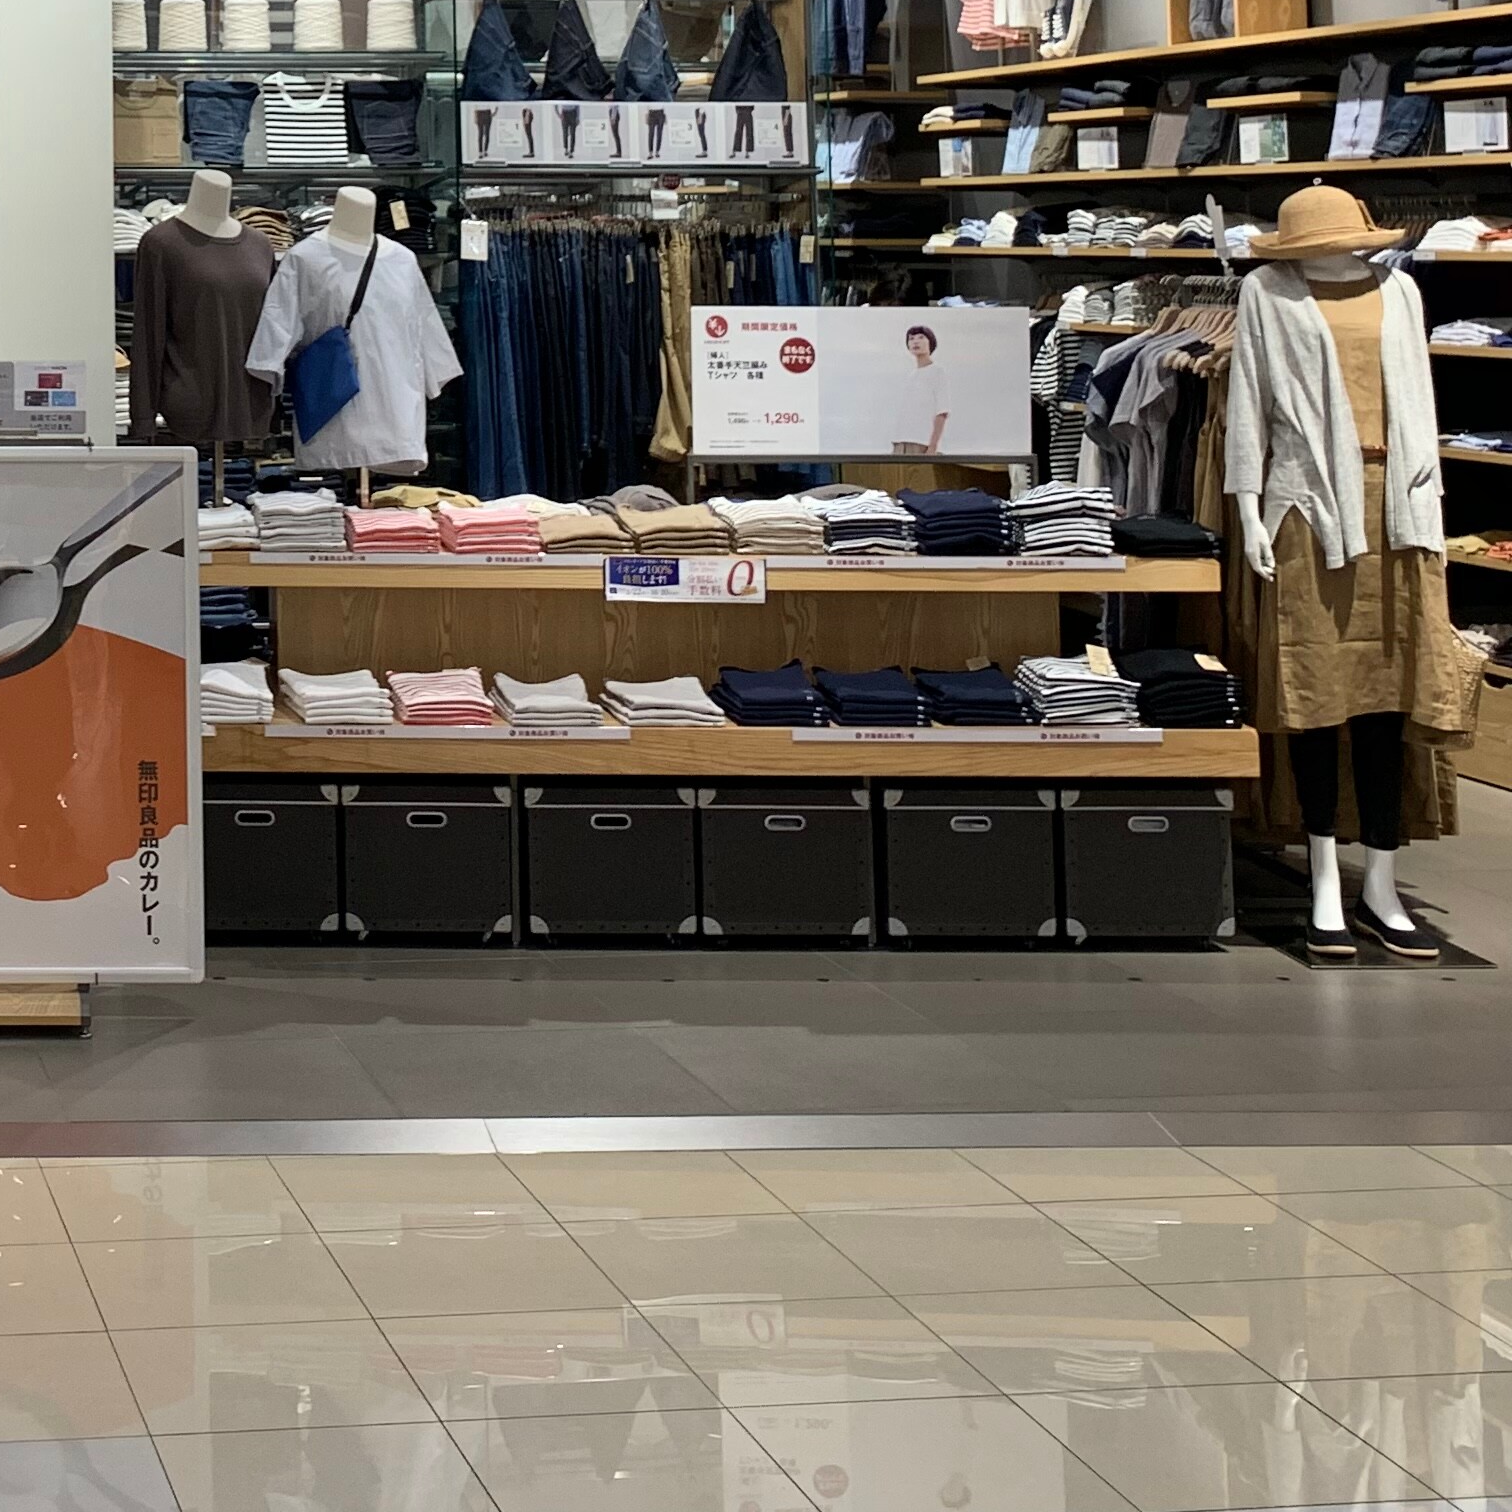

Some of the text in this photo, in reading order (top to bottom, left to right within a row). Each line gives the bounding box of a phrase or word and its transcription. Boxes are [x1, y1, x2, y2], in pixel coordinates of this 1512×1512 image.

[137, 759, 160, 945] 無印良品のカレー。
